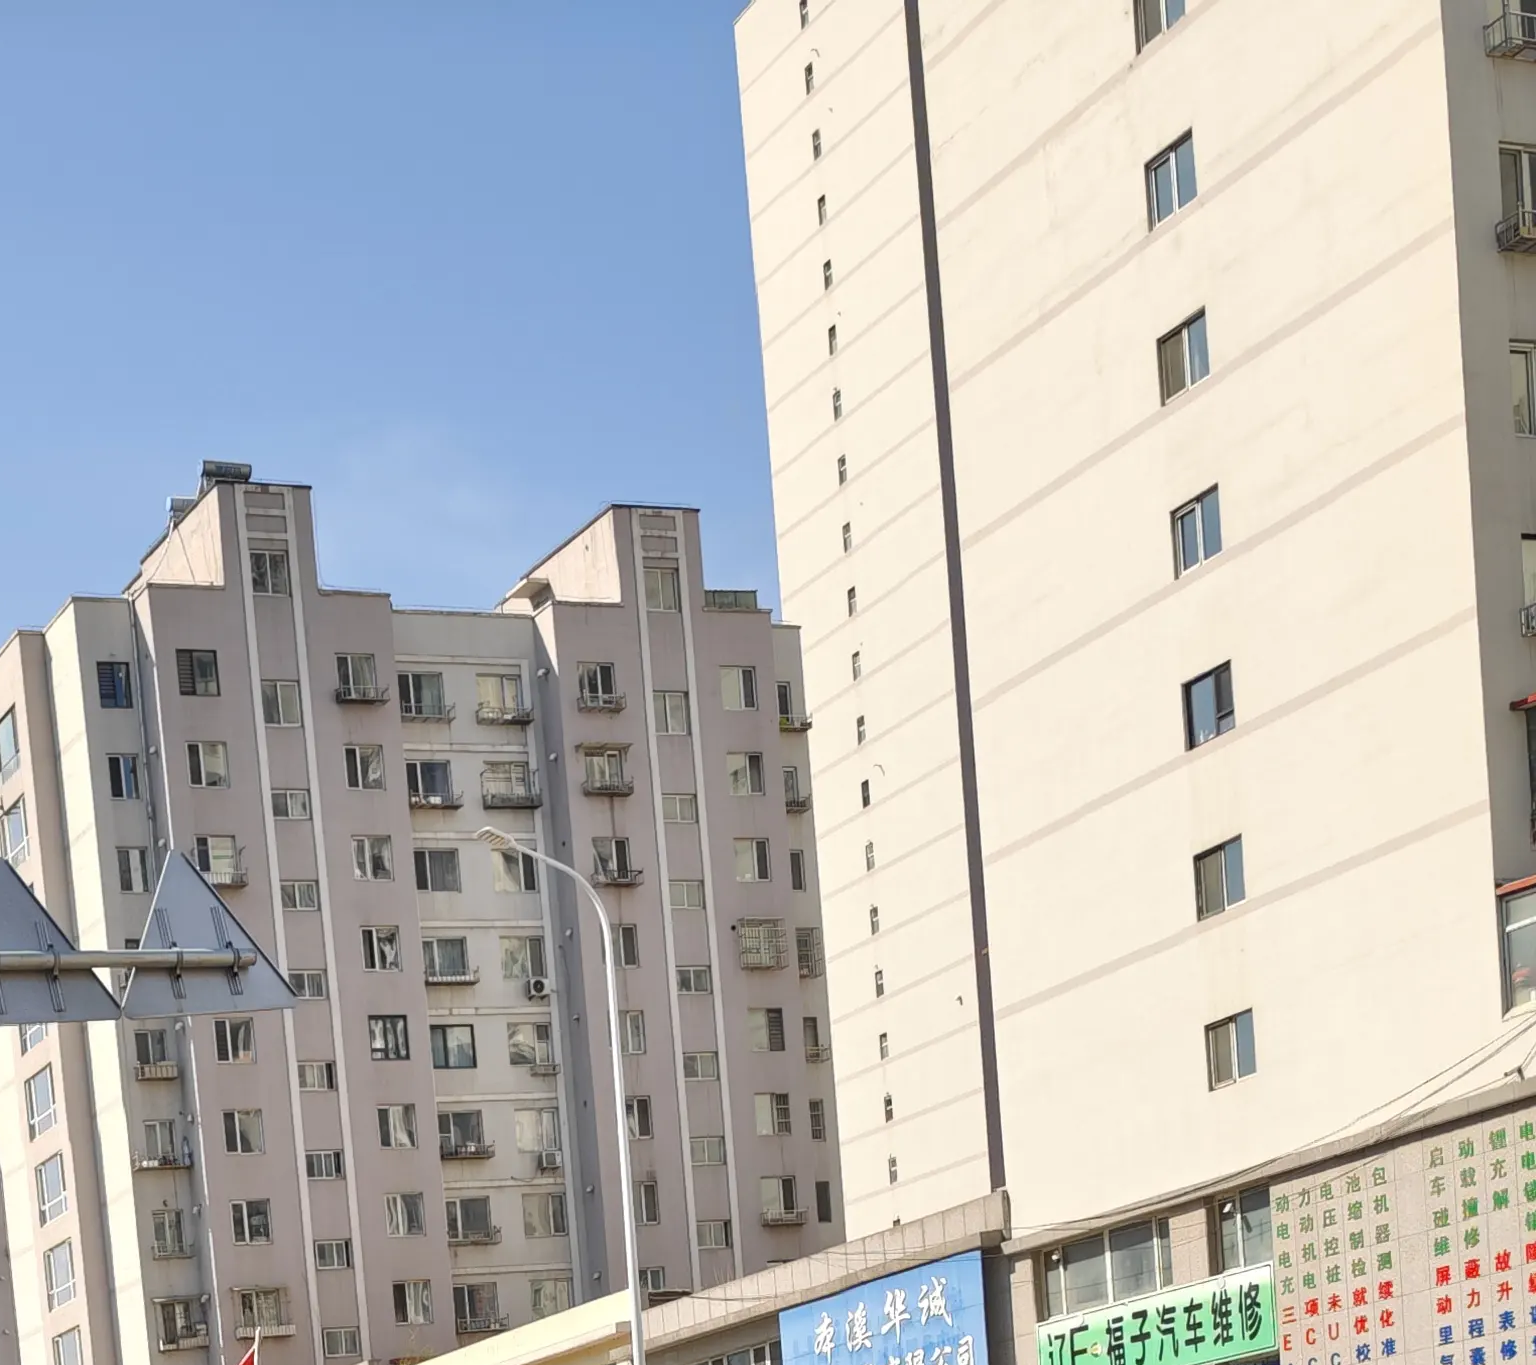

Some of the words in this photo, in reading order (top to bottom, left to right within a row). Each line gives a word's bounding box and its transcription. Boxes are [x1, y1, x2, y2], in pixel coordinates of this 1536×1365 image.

[1429, 1121, 1536, 1169] 启动锂电
[1275, 1167, 1388, 1214] 动力电池包
[1276, 1193, 1390, 1241] 电动压缩机
[1277, 1223, 1392, 1269] 电机控制器
[1434, 1226, 1481, 1257] 维修
[1279, 1251, 1393, 1296] 充电桩检测
[814, 1276, 954, 1365] 本溪华诚
